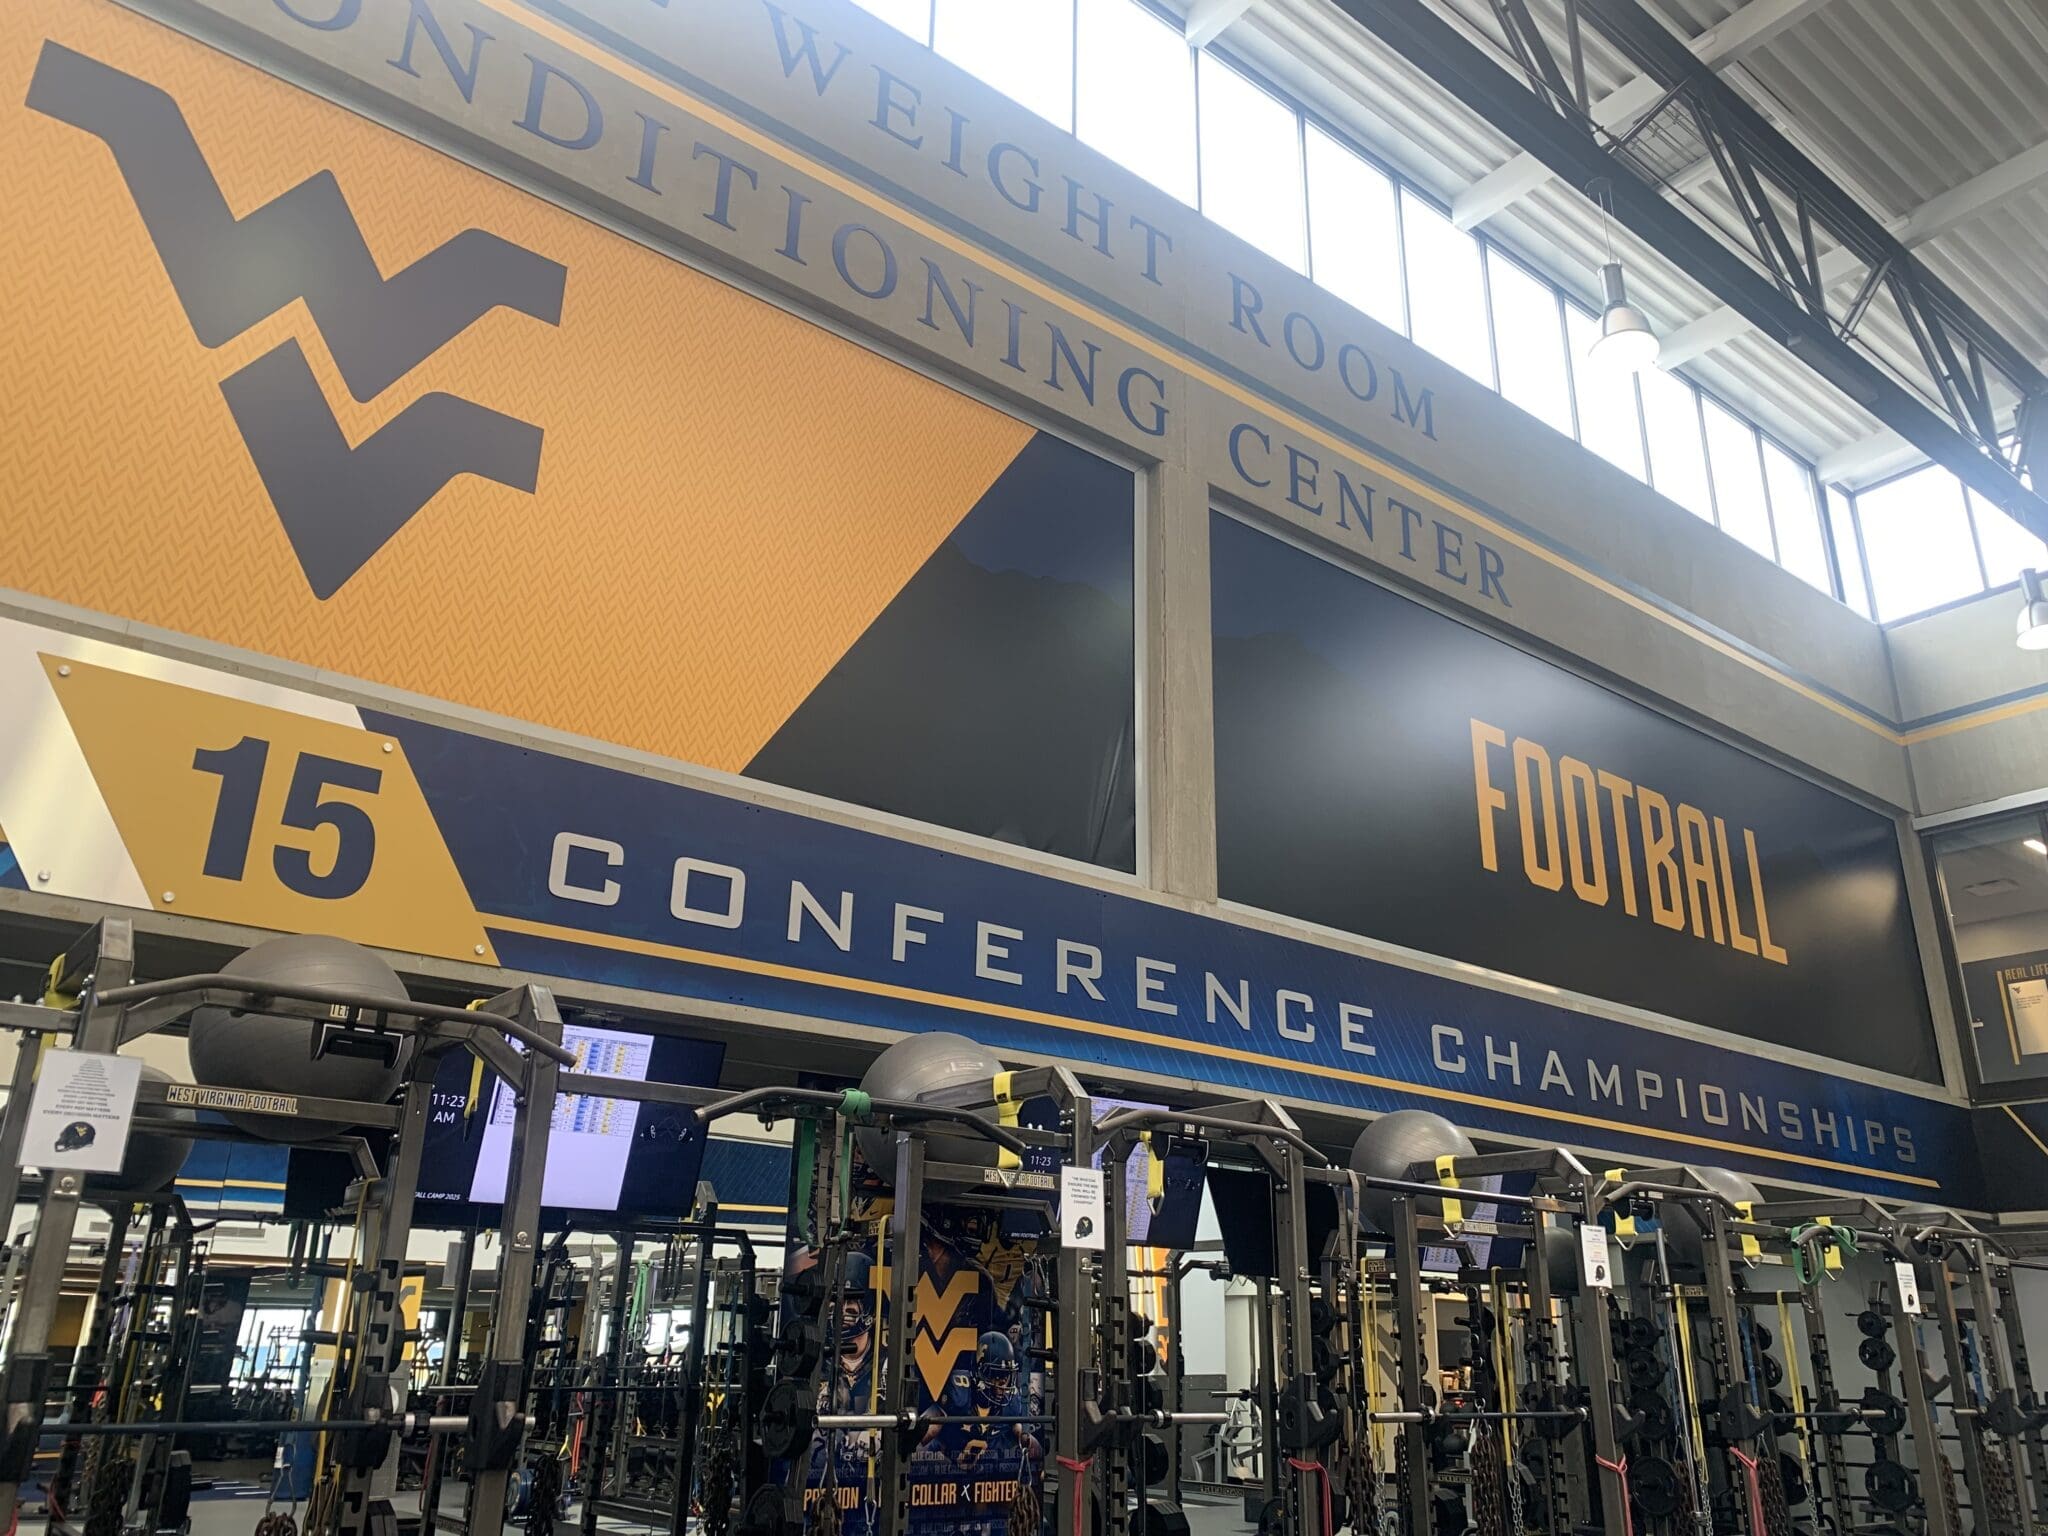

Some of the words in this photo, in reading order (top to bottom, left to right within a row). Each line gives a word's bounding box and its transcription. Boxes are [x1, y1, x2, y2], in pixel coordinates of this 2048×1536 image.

[763, 2, 1173, 287] WEIGHT
[1224, 271, 1439, 442] ROOM
[1228, 423, 1513, 608] CENTER
[1470, 717, 1788, 966] FOOTBALL
[192, 735, 383, 900] 15
[548, 831, 1377, 1056] CONFERENCE
[1430, 1023, 1917, 1164] CHAMPIONSHIPS
[167, 1085, 199, 1104] WEST
[199, 1088, 247, 1109] VIRGINIA
[246, 1093, 297, 1114] FOOTBALL
[432, 1093, 466, 1108] 11:23
[433, 1111, 456, 1124] AM
[427, 1191, 445, 1200] CAMP
[912, 1483, 957, 1506] COLLAR
